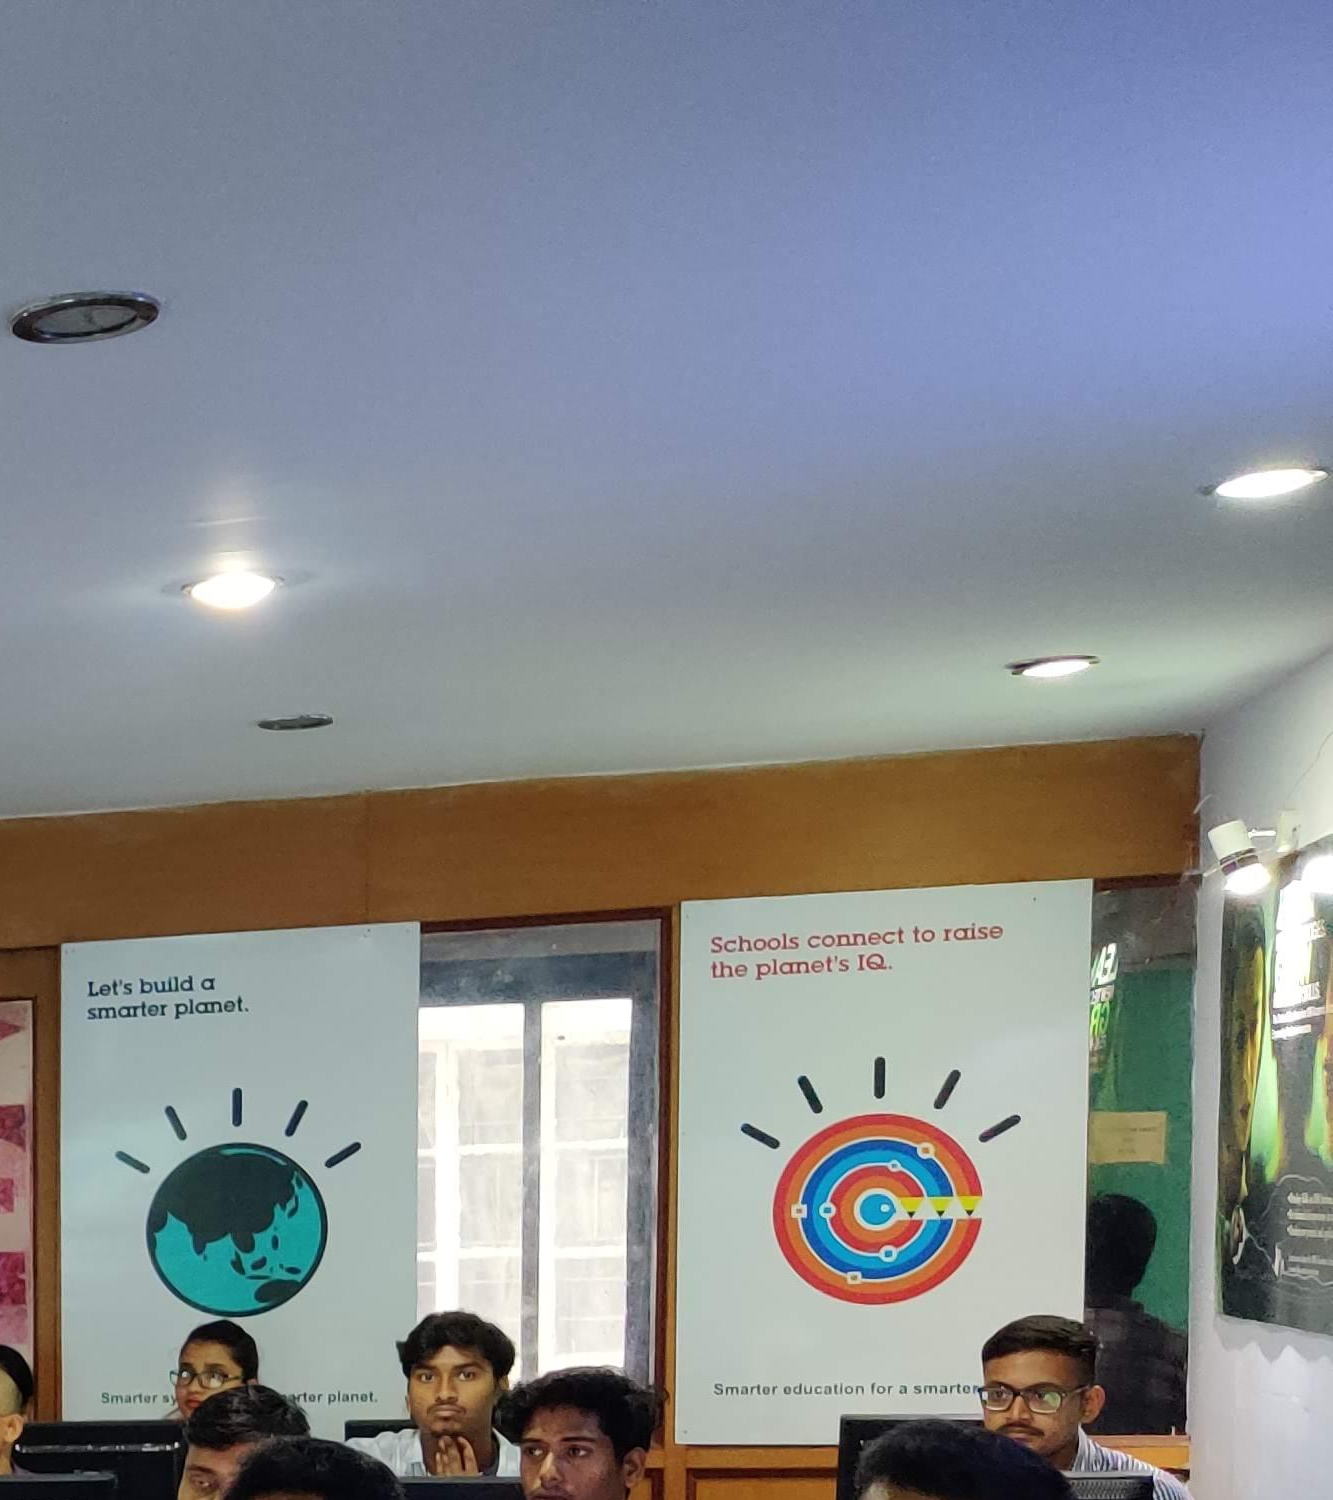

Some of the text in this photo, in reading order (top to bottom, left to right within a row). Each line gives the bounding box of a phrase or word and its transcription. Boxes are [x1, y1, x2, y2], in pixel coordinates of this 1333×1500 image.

[710, 923, 1004, 953] Schools connect to raise
[711, 953, 892, 980] the planet's IQ.
[87, 975, 215, 997] Let's build a
[87, 995, 249, 1020] smarter planet.
[101, 1392, 158, 1404] Smarter
[328, 1390, 378, 1405] planet.
[713, 1383, 777, 1396] Smarter
[783, 1382, 865, 1396] education
[871, 1382, 893, 1395] for
[899, 1384, 908, 1395] a
